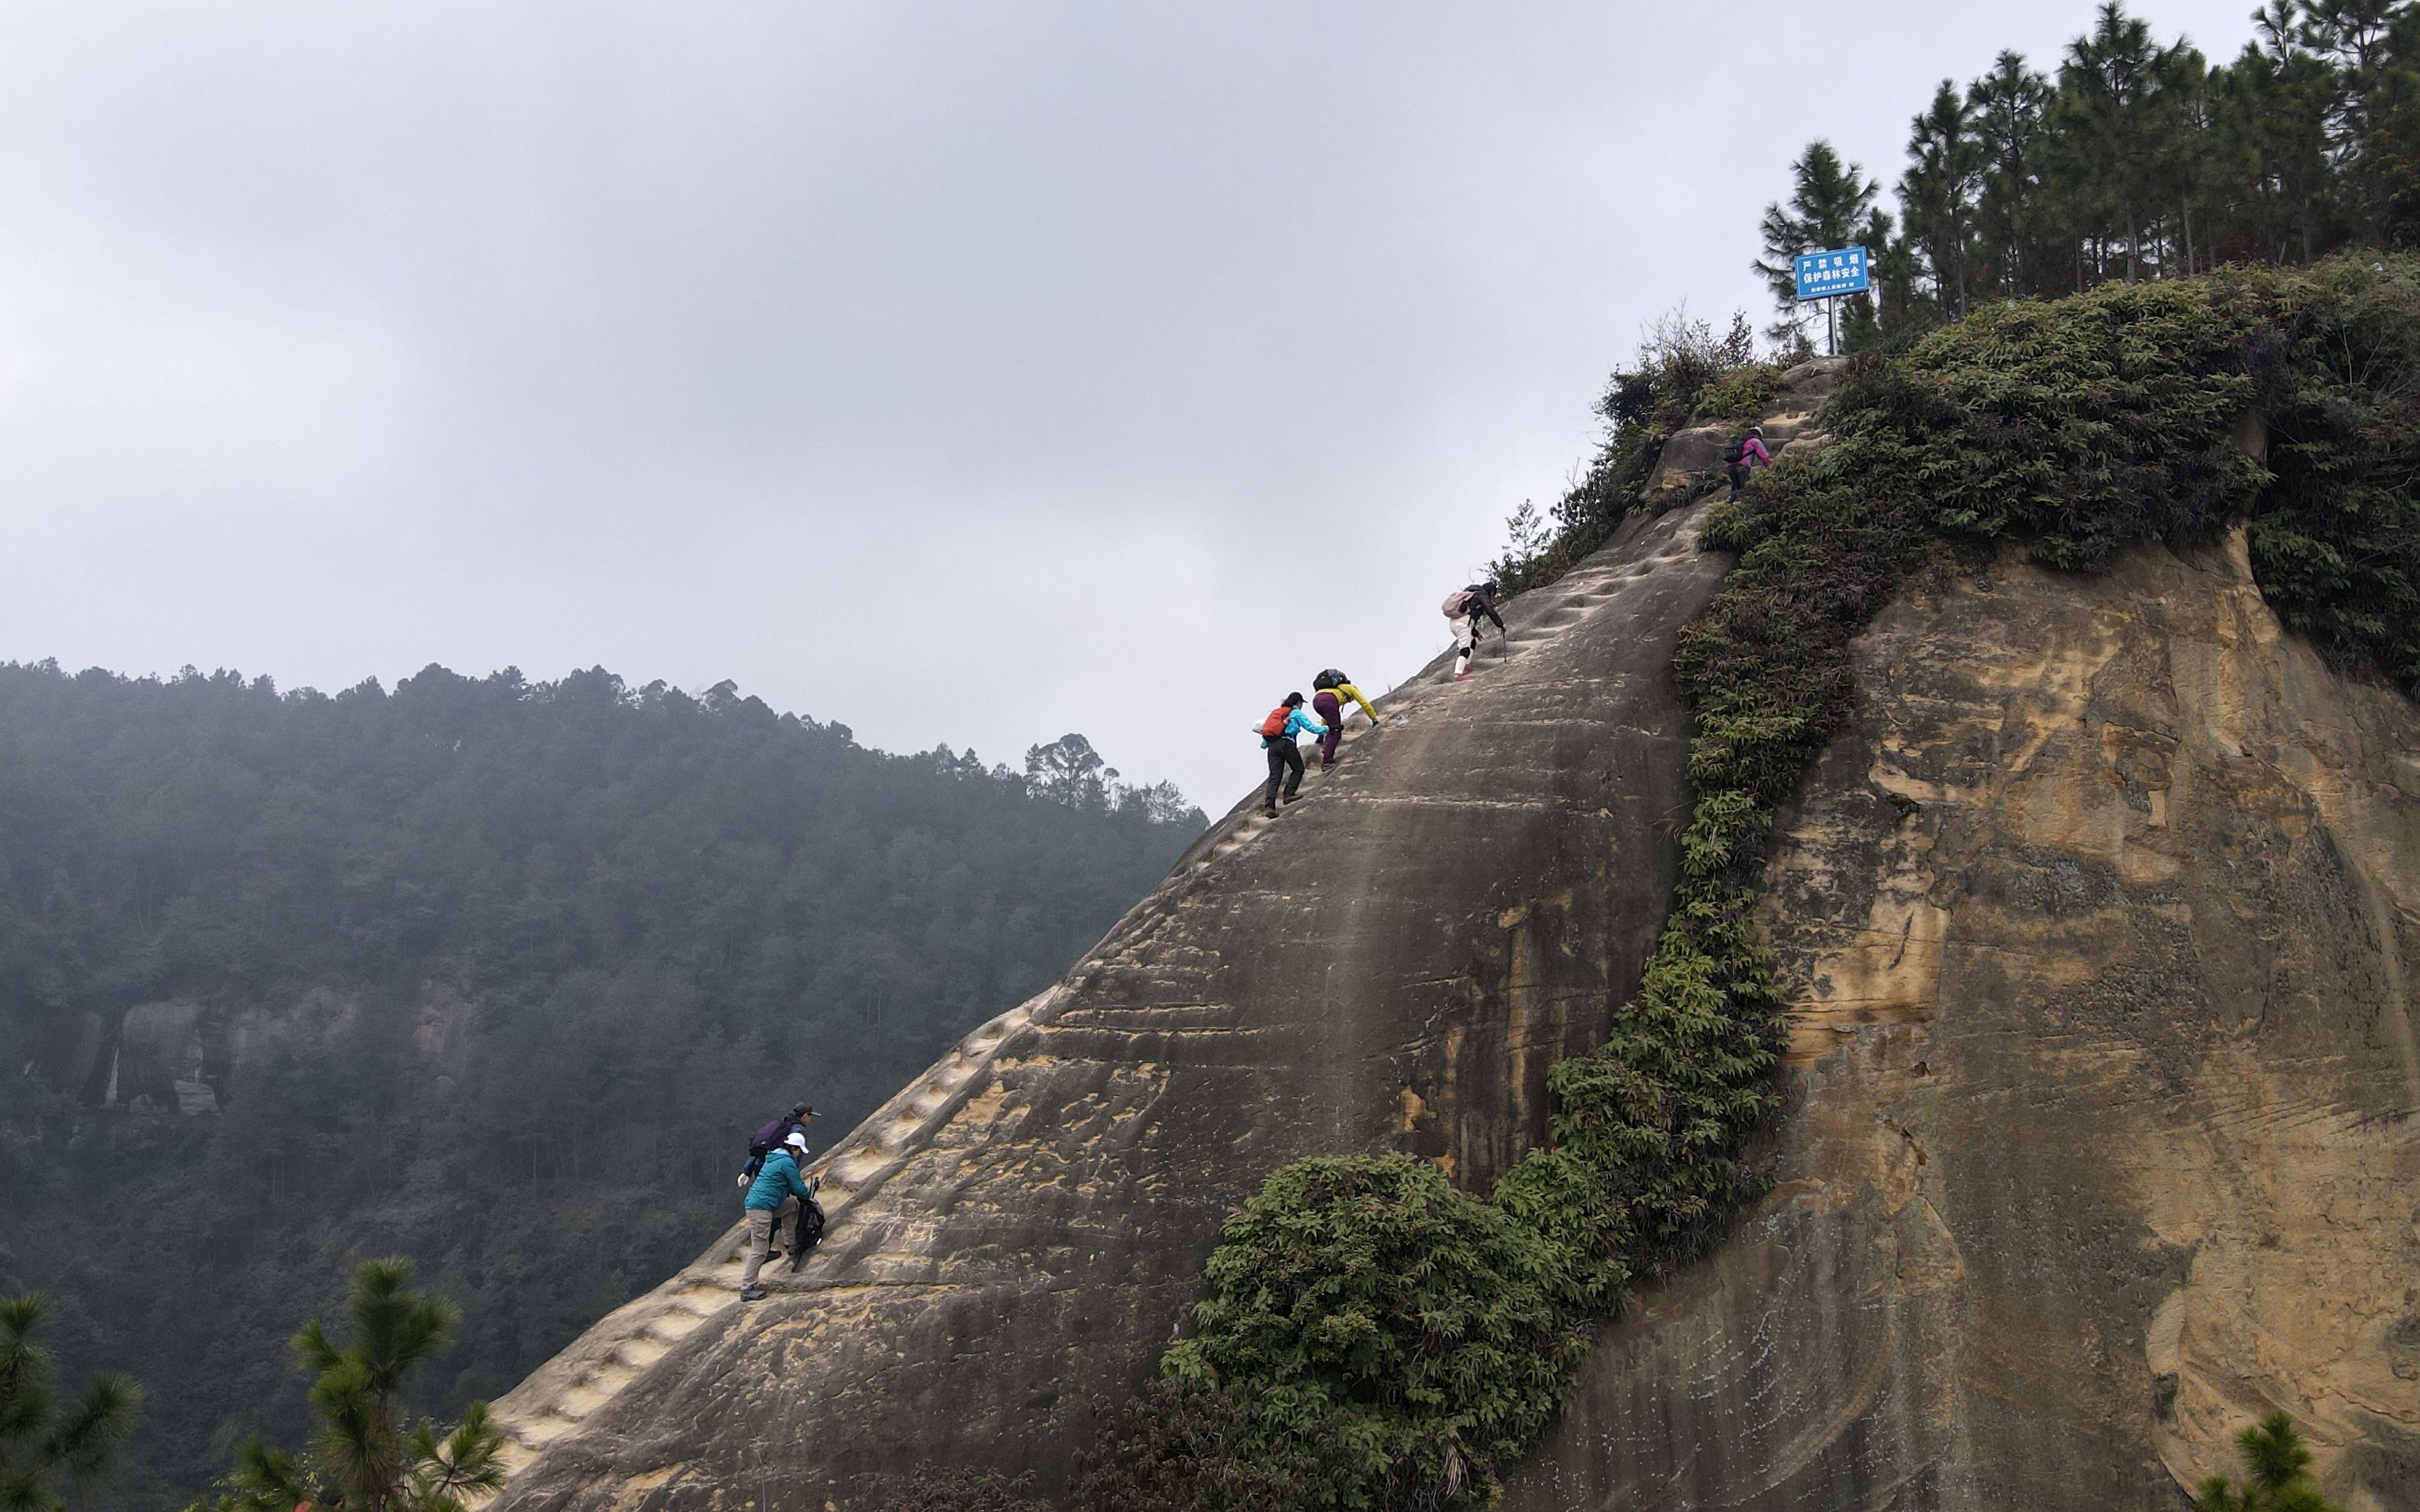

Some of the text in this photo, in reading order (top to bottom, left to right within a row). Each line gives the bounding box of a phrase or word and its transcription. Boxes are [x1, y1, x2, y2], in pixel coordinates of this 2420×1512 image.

[1804, 265, 1859, 284] 保护森林安全
